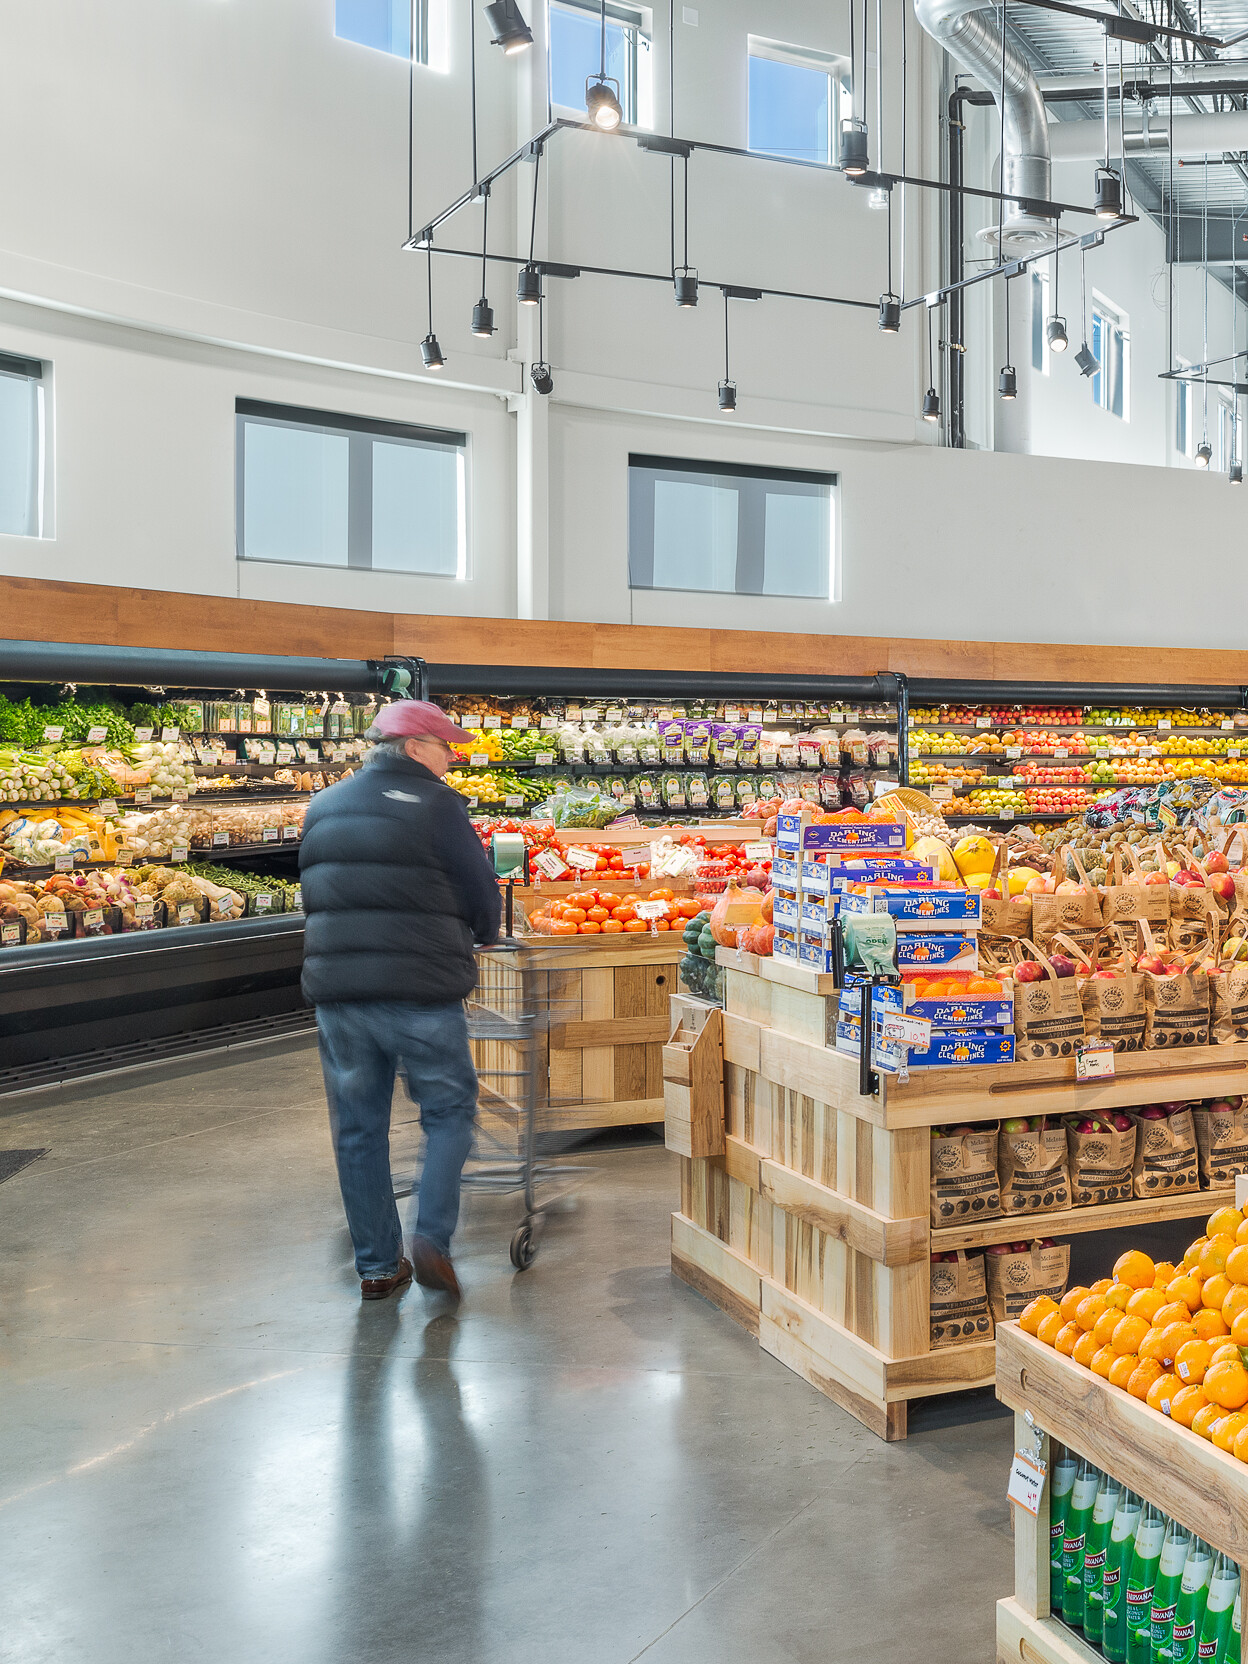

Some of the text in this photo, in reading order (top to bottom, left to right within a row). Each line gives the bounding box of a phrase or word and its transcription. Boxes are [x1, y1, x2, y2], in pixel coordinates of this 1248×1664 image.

[830, 829, 876, 838] DARLING
[828, 836, 876, 844] CLEMENTINES
[861, 872, 904, 882] DARLING
[905, 896, 949, 908] DARLING
[904, 906, 950, 915] CLEMENTINES
[900, 941, 945, 952] DARLING
[898, 951, 945, 960] CLEMENTINES
[936, 1005, 983, 1015] DARLING
[934, 1012, 983, 1022] CLEMENTINES
[940, 1041, 985, 1052] DARLING
[938, 1050, 985, 1061] CLEMENTINES
[952, 1174, 987, 1184] VERMONT
[960, 1188, 983, 1196] APPLES
[1022, 1289, 1055, 1298] VERMONT
[945, 1299, 978, 1308] VERMONT
[1129, 1592, 1152, 1601] NIRVANA
[1152, 1610, 1174, 1619] NIRVANA
